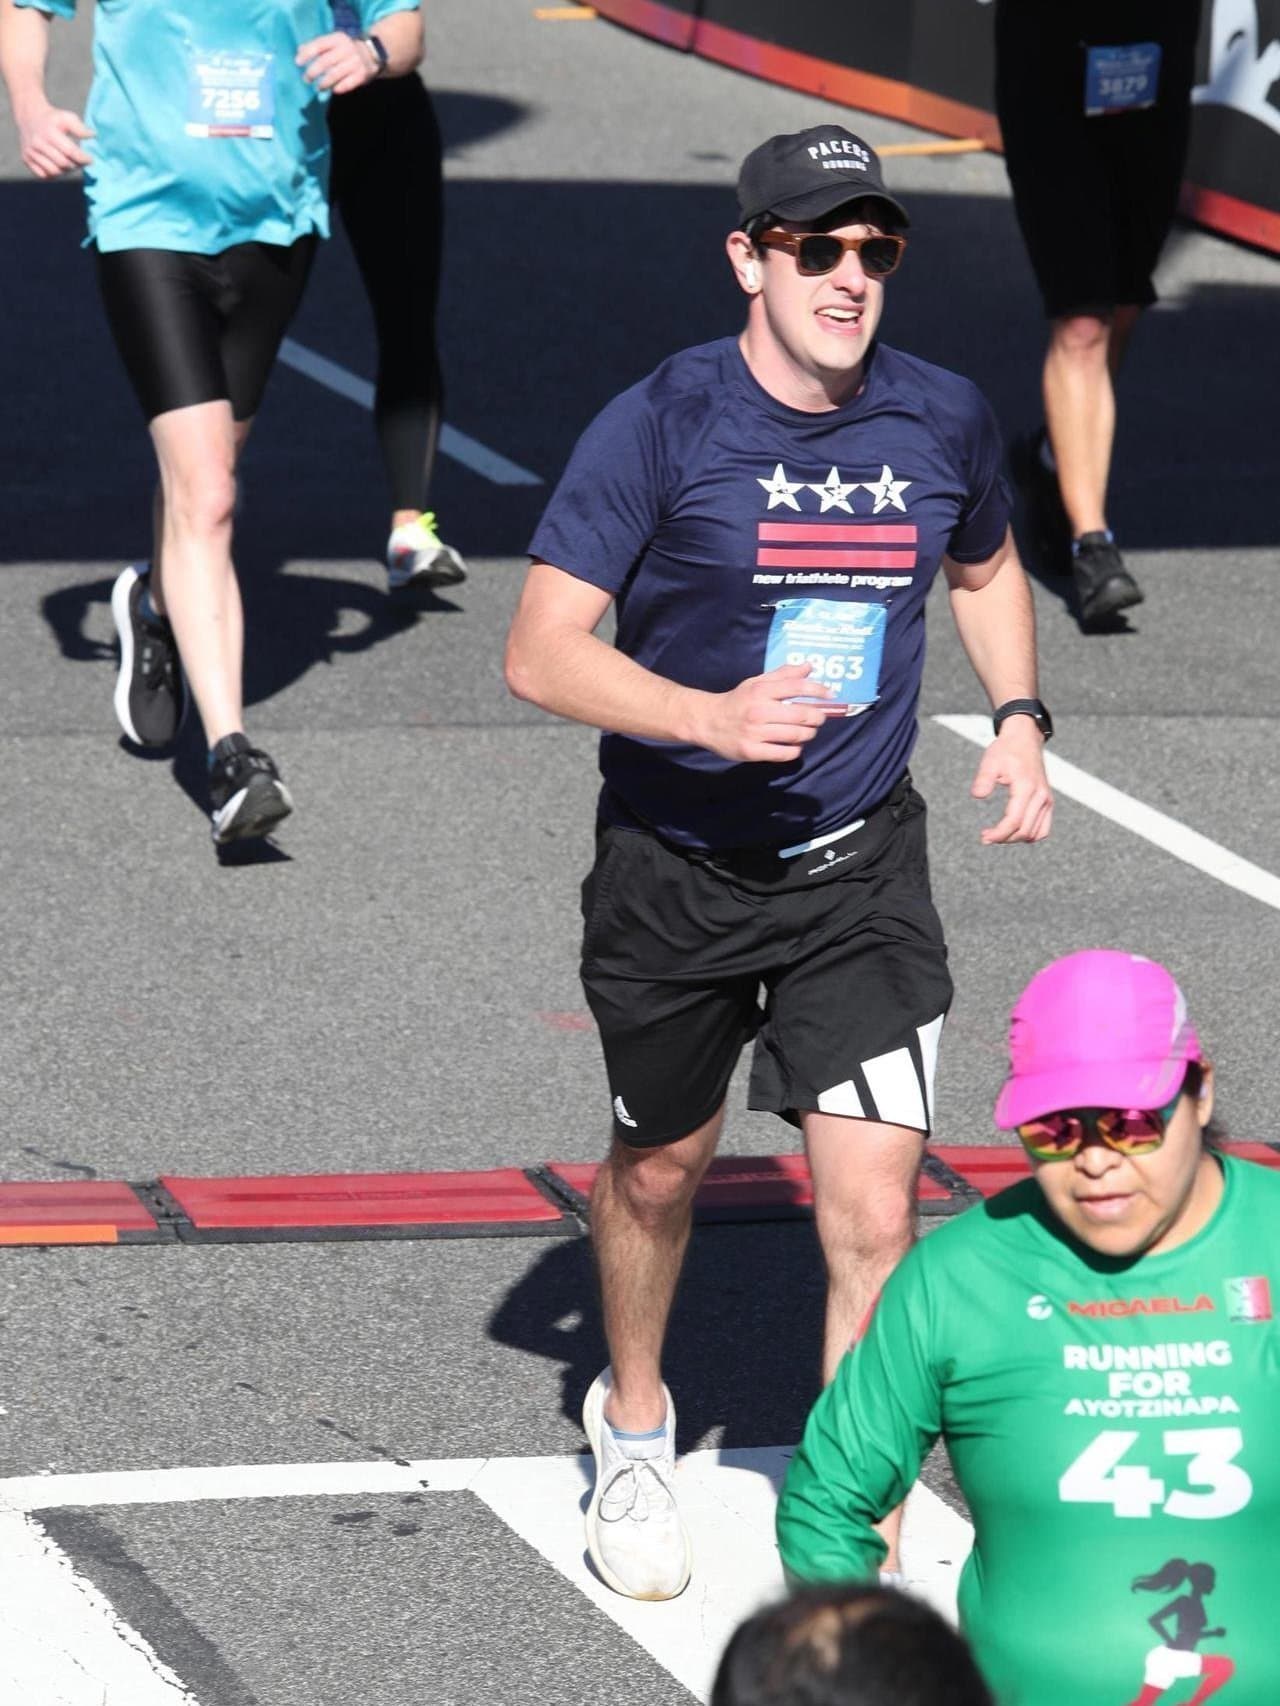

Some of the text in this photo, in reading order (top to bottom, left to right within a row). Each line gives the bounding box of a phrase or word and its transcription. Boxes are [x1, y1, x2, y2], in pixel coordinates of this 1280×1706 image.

[807, 140, 870, 163] PACERS
[752, 573, 913, 589] new triathlete program
[1067, 1295, 1214, 1318] MICAELA
[1063, 1340, 1232, 1371] RUNNING
[1108, 1370, 1192, 1398] FOR
[1064, 1396, 1240, 1418] AYOTZINAPA
[1058, 1427, 1253, 1519] 43
